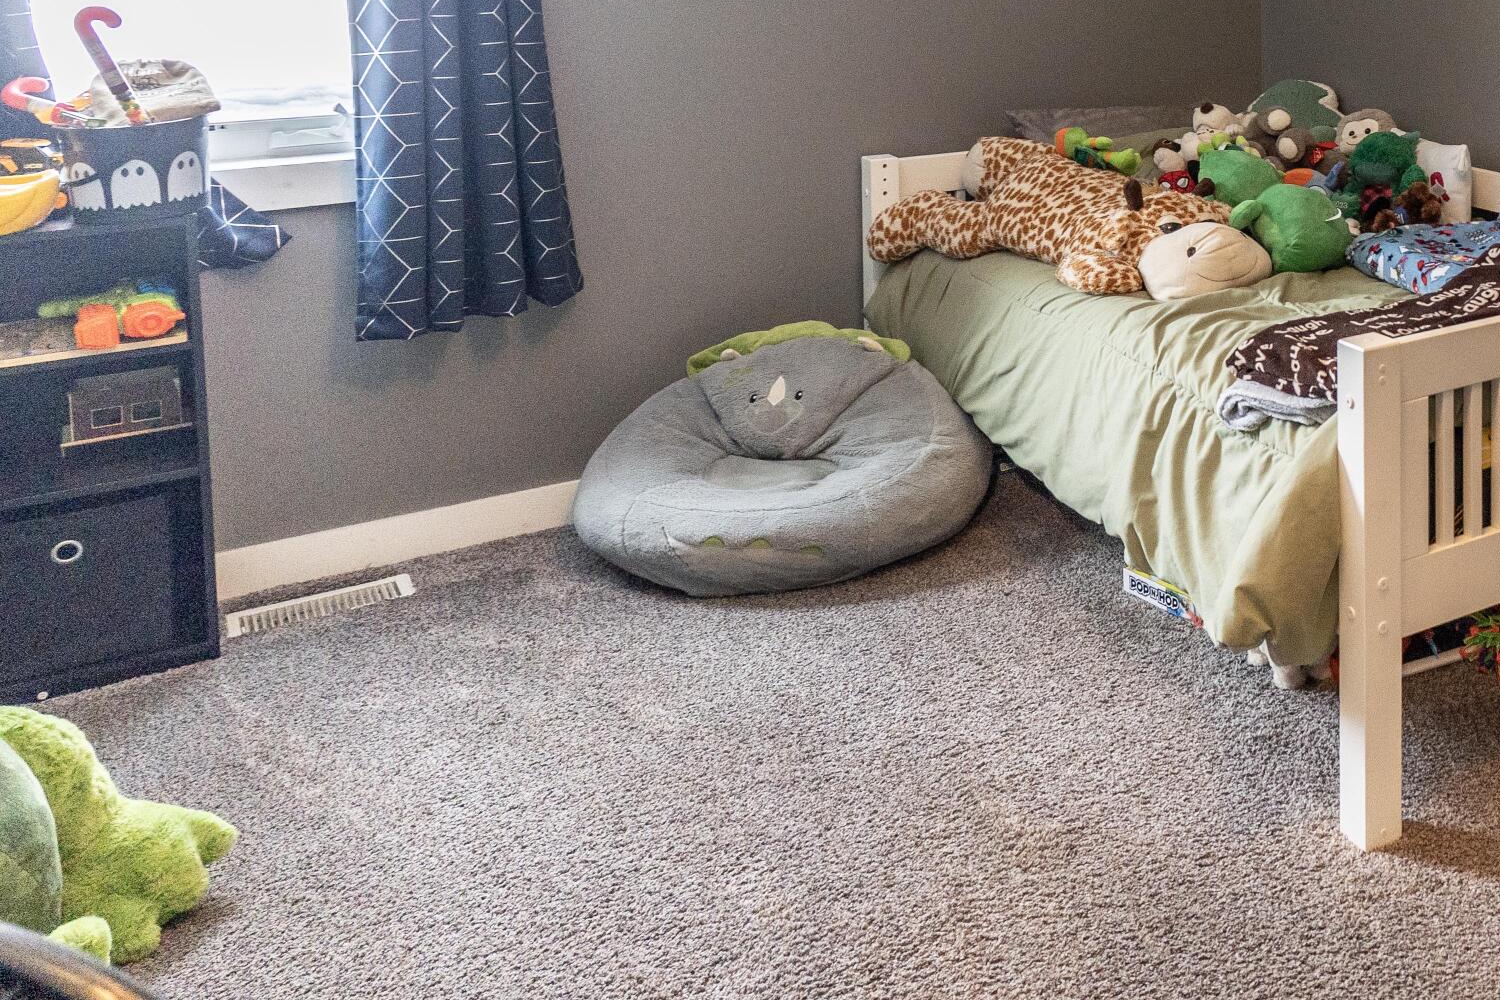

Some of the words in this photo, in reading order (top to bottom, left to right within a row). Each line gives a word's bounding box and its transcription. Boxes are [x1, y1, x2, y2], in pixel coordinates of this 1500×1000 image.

[1416, 284, 1474, 306] Laugh
[1409, 310, 1452, 321] Love
[1273, 320, 1328, 334] Laugh
[1130, 576, 1150, 596] POP
[1158, 592, 1179, 609] HOP
